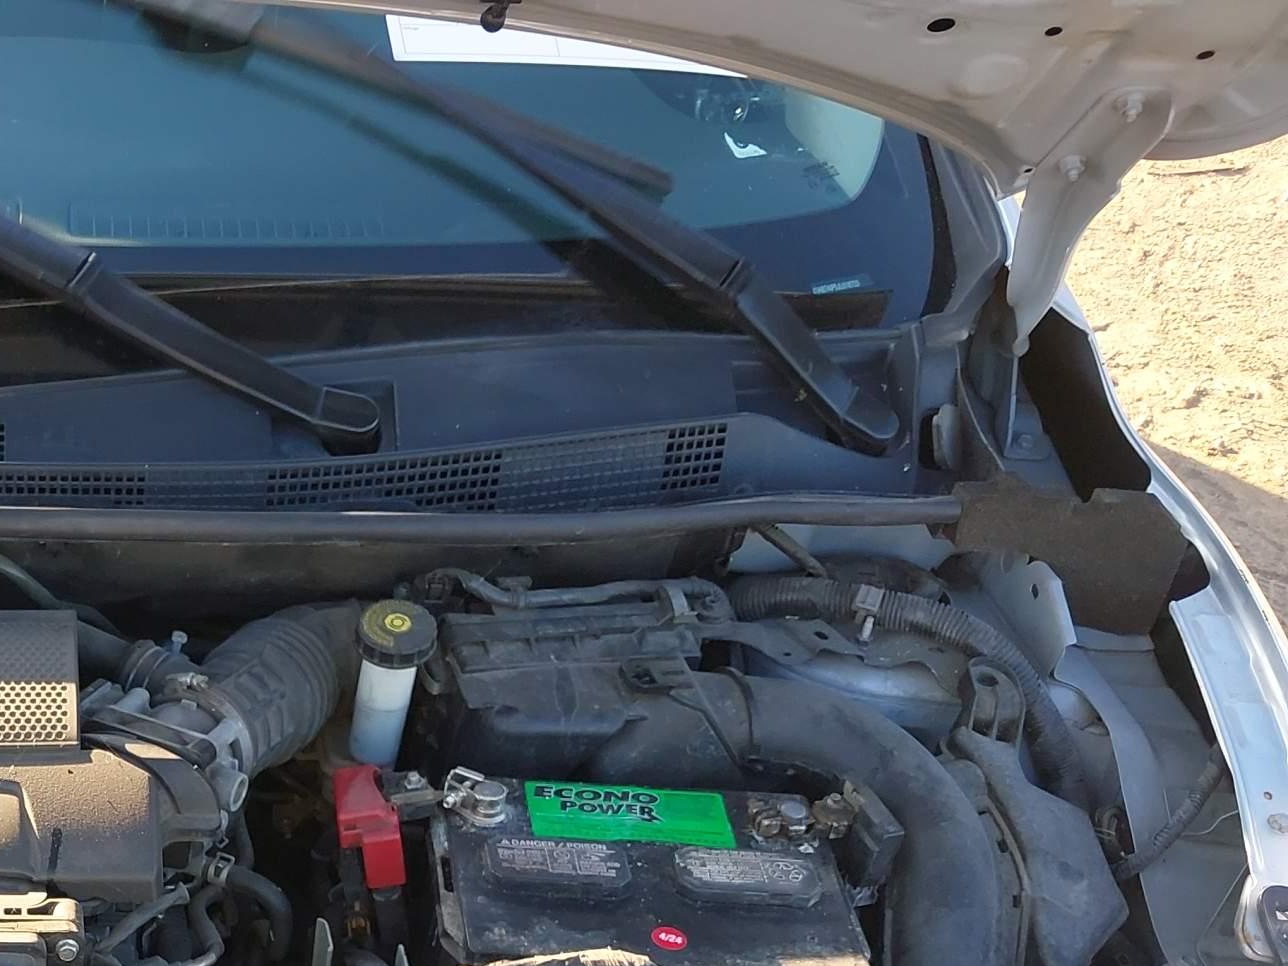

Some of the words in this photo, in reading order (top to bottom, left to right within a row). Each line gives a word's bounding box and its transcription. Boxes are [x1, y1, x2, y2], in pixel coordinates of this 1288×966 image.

[533, 784, 660, 806] ECONO
[559, 800, 664, 823] POWER
[511, 839, 556, 849] DANGER
[566, 842, 607, 851] POISON
[658, 931, 683, 945] 4/24
